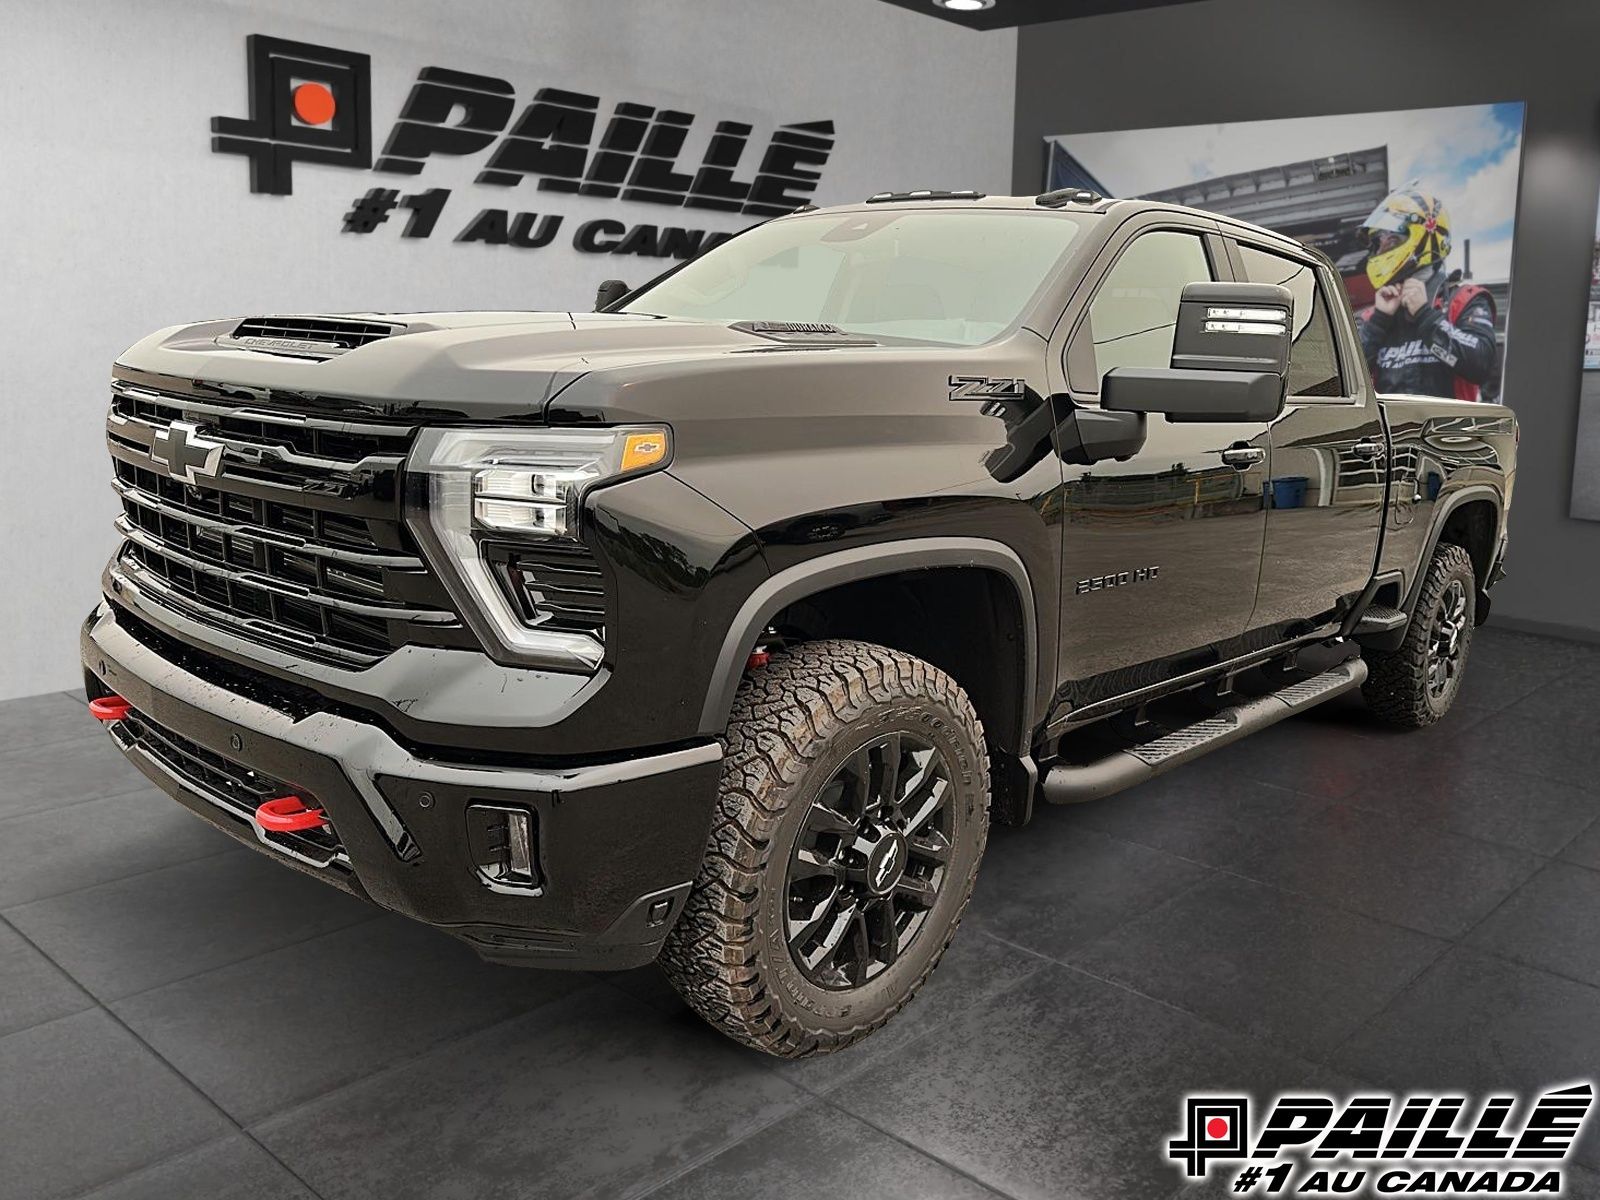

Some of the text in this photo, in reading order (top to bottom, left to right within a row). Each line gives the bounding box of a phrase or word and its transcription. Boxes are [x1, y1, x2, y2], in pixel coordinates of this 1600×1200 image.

[373, 66, 835, 215] PAILLÉ
[341, 187, 733, 259] #1 AU CAN
[1132, 565, 1160, 583] HD
